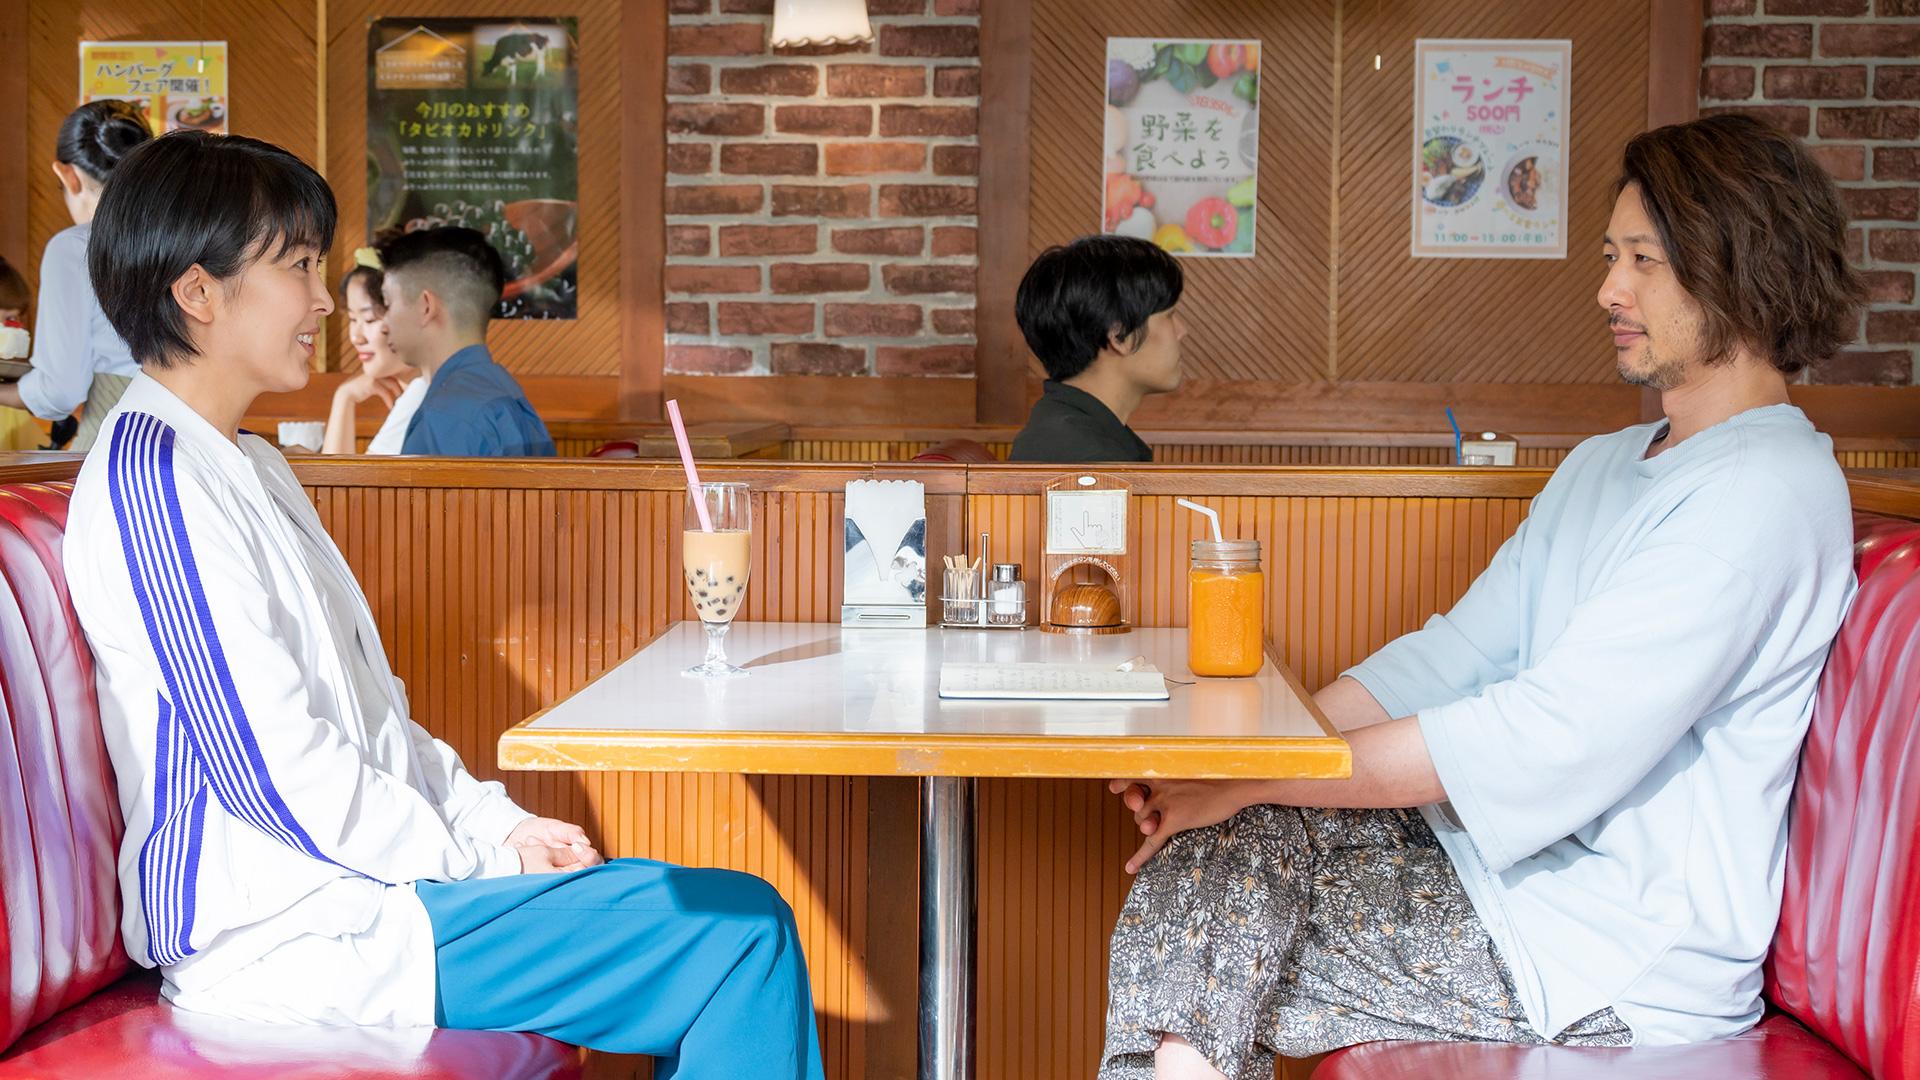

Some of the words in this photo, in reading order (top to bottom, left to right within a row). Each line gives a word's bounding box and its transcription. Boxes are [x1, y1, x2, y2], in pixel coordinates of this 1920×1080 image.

[96, 62, 174, 77] ハンバーグ
[1452, 76, 1533, 103] ランチ
[416, 101, 529, 118] 今月のおすすめ
[1467, 105, 1520, 121] 500円
[399, 121, 546, 139] 「タピオカドリンク」
[1141, 112, 1222, 141] 野菜を
[1132, 142, 1231, 172] 食べよう
